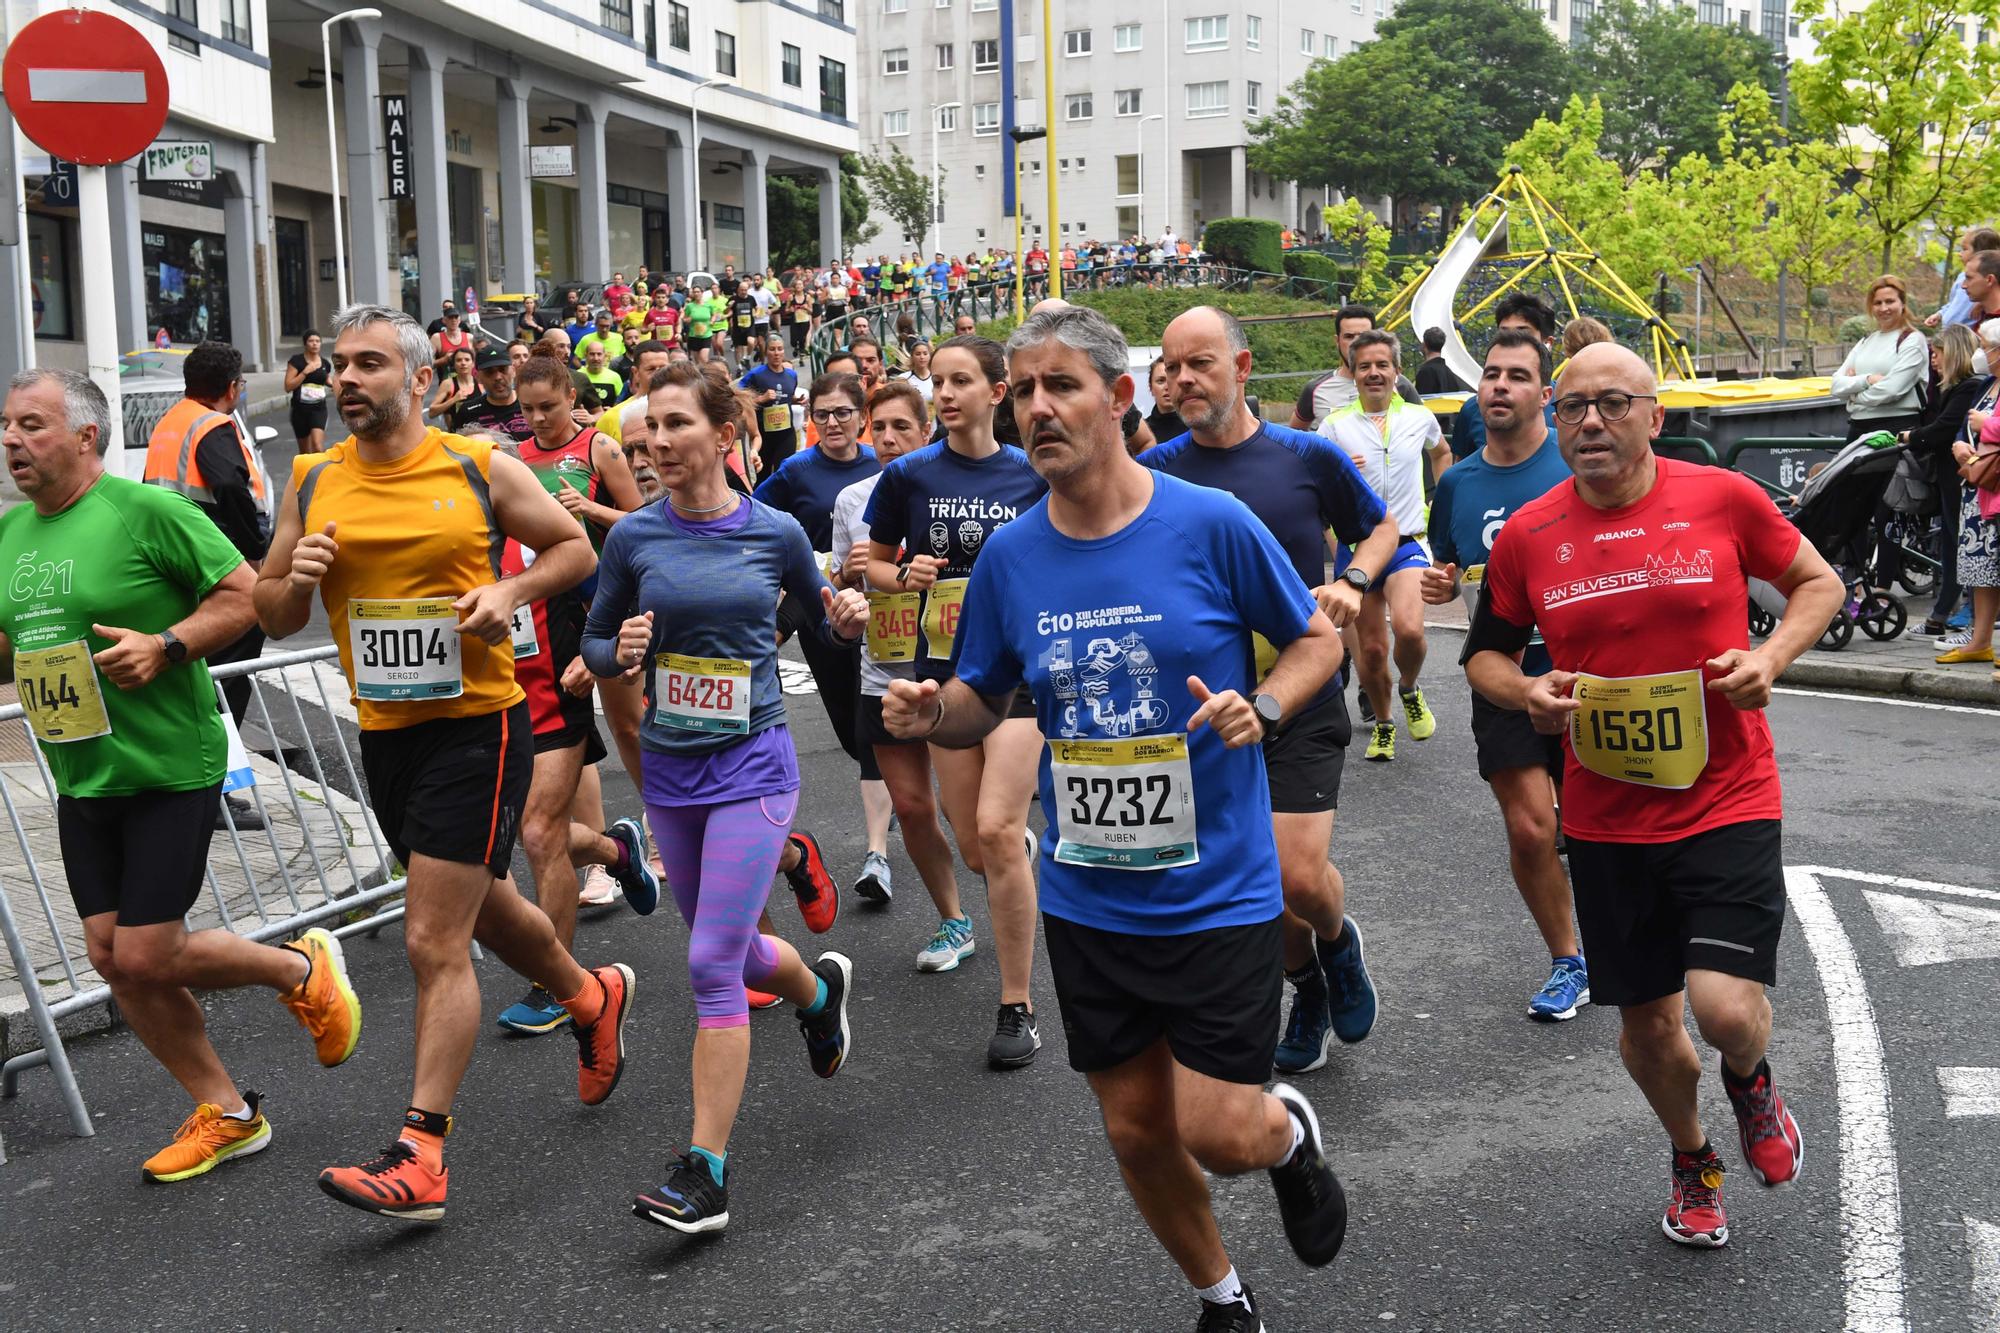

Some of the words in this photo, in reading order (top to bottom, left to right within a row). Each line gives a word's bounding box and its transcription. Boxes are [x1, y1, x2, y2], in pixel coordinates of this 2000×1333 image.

[387, 99, 405, 195] MALER
[147, 144, 208, 176] FRUTERIA
[929, 496, 968, 504] escuela
[929, 502, 1017, 520] TRIATLÓN
[1595, 528, 1646, 542] ABANCA
[1650, 578, 1674, 587] 2021
[1543, 586, 1567, 604] SAN
[40, 606, 64, 617] Maratón
[1075, 612, 1091, 621] XIII
[1092, 605, 1143, 618] CARREIRA
[875, 608, 917, 639] 346
[1076, 617, 1122, 629] POPULAR
[1124, 614, 1163, 624] 06.10.2019
[360, 628, 448, 668] 3004
[387, 672, 419, 681] SERGIO
[668, 673, 734, 710] 6428
[1590, 707, 1682, 752] 1530
[1623, 756, 1654, 765] JHONY
[1067, 774, 1174, 827] 3232
[1104, 833, 1137, 843] RUBEN
[1107, 853, 1131, 862] 22.05
